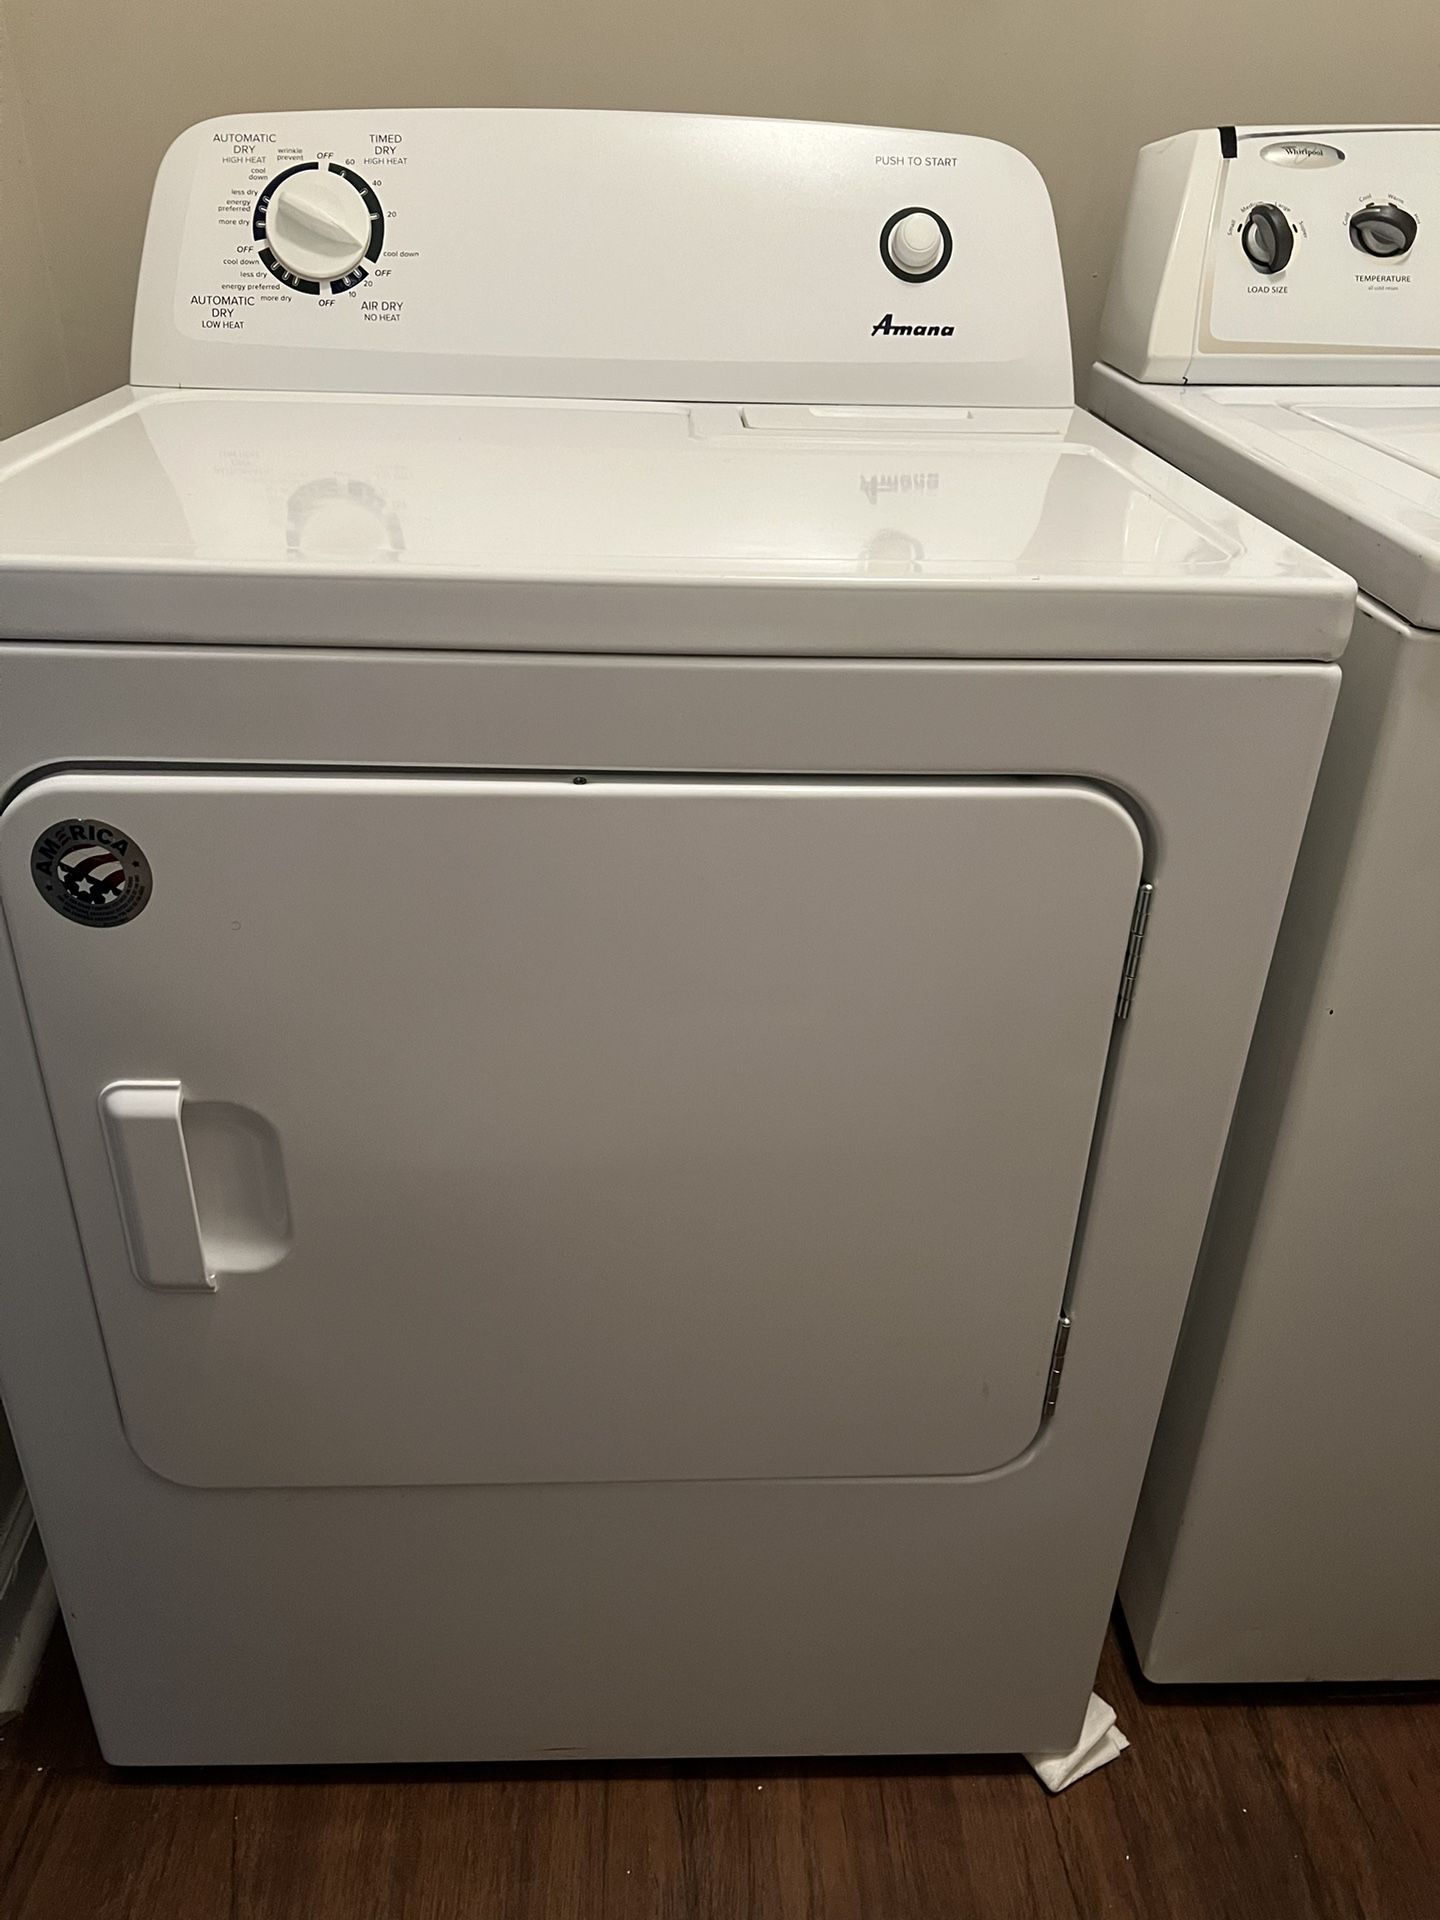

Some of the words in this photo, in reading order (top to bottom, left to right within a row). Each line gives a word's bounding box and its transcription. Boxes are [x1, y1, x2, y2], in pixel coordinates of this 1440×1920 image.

[212, 133, 277, 143] AUTOMATIC
[369, 134, 403, 144] TIMED
[233, 145, 256, 154] DRY
[374, 145, 397, 155] DRY
[1281, 145, 1324, 157] Whirlpool
[222, 156, 244, 164] HIGH
[245, 156, 267, 164] HEAT
[316, 152, 334, 160] OFF
[345, 158, 356, 166] 60
[363, 157, 385, 165] HIGH
[386, 157, 408, 165] HEAT
[875, 155, 905, 166] PUSH
[908, 156, 923, 167] TO
[925, 156, 957, 167] START
[372, 179, 382, 187] 40
[231, 188, 245, 196] less
[246, 189, 259, 197] dry
[226, 199, 251, 207] energy
[217, 205, 251, 213] preferred
[387, 210, 397, 218] 20
[238, 218, 250, 227] dry
[236, 246, 254, 254] OFF
[383, 250, 399, 258] cool
[222, 258, 239, 266] cool
[239, 258, 260, 266] down
[255, 271, 268, 279] dry
[374, 269, 392, 278] OFF
[1354, 274, 1411, 283] TEMPERATURE
[247, 284, 281, 292] preferred
[363, 280, 374, 288] 20
[1247, 286, 1270, 294] LOAD
[1271, 286, 1288, 294] SIZE
[280, 294, 293, 304] dry
[348, 291, 357, 299] 10
[190, 295, 256, 307] AUTOMATIC
[318, 299, 336, 308] OFF
[360, 301, 379, 311] AIR
[381, 301, 404, 312] DRY
[211, 307, 235, 318] DRY
[364, 313, 378, 321] NO
[379, 313, 401, 322] HEAT
[201, 320, 221, 329] LOW
[222, 320, 245, 329] HEAT
[871, 313, 955, 337] Amana
[35, 825, 129, 877] AMERICA
